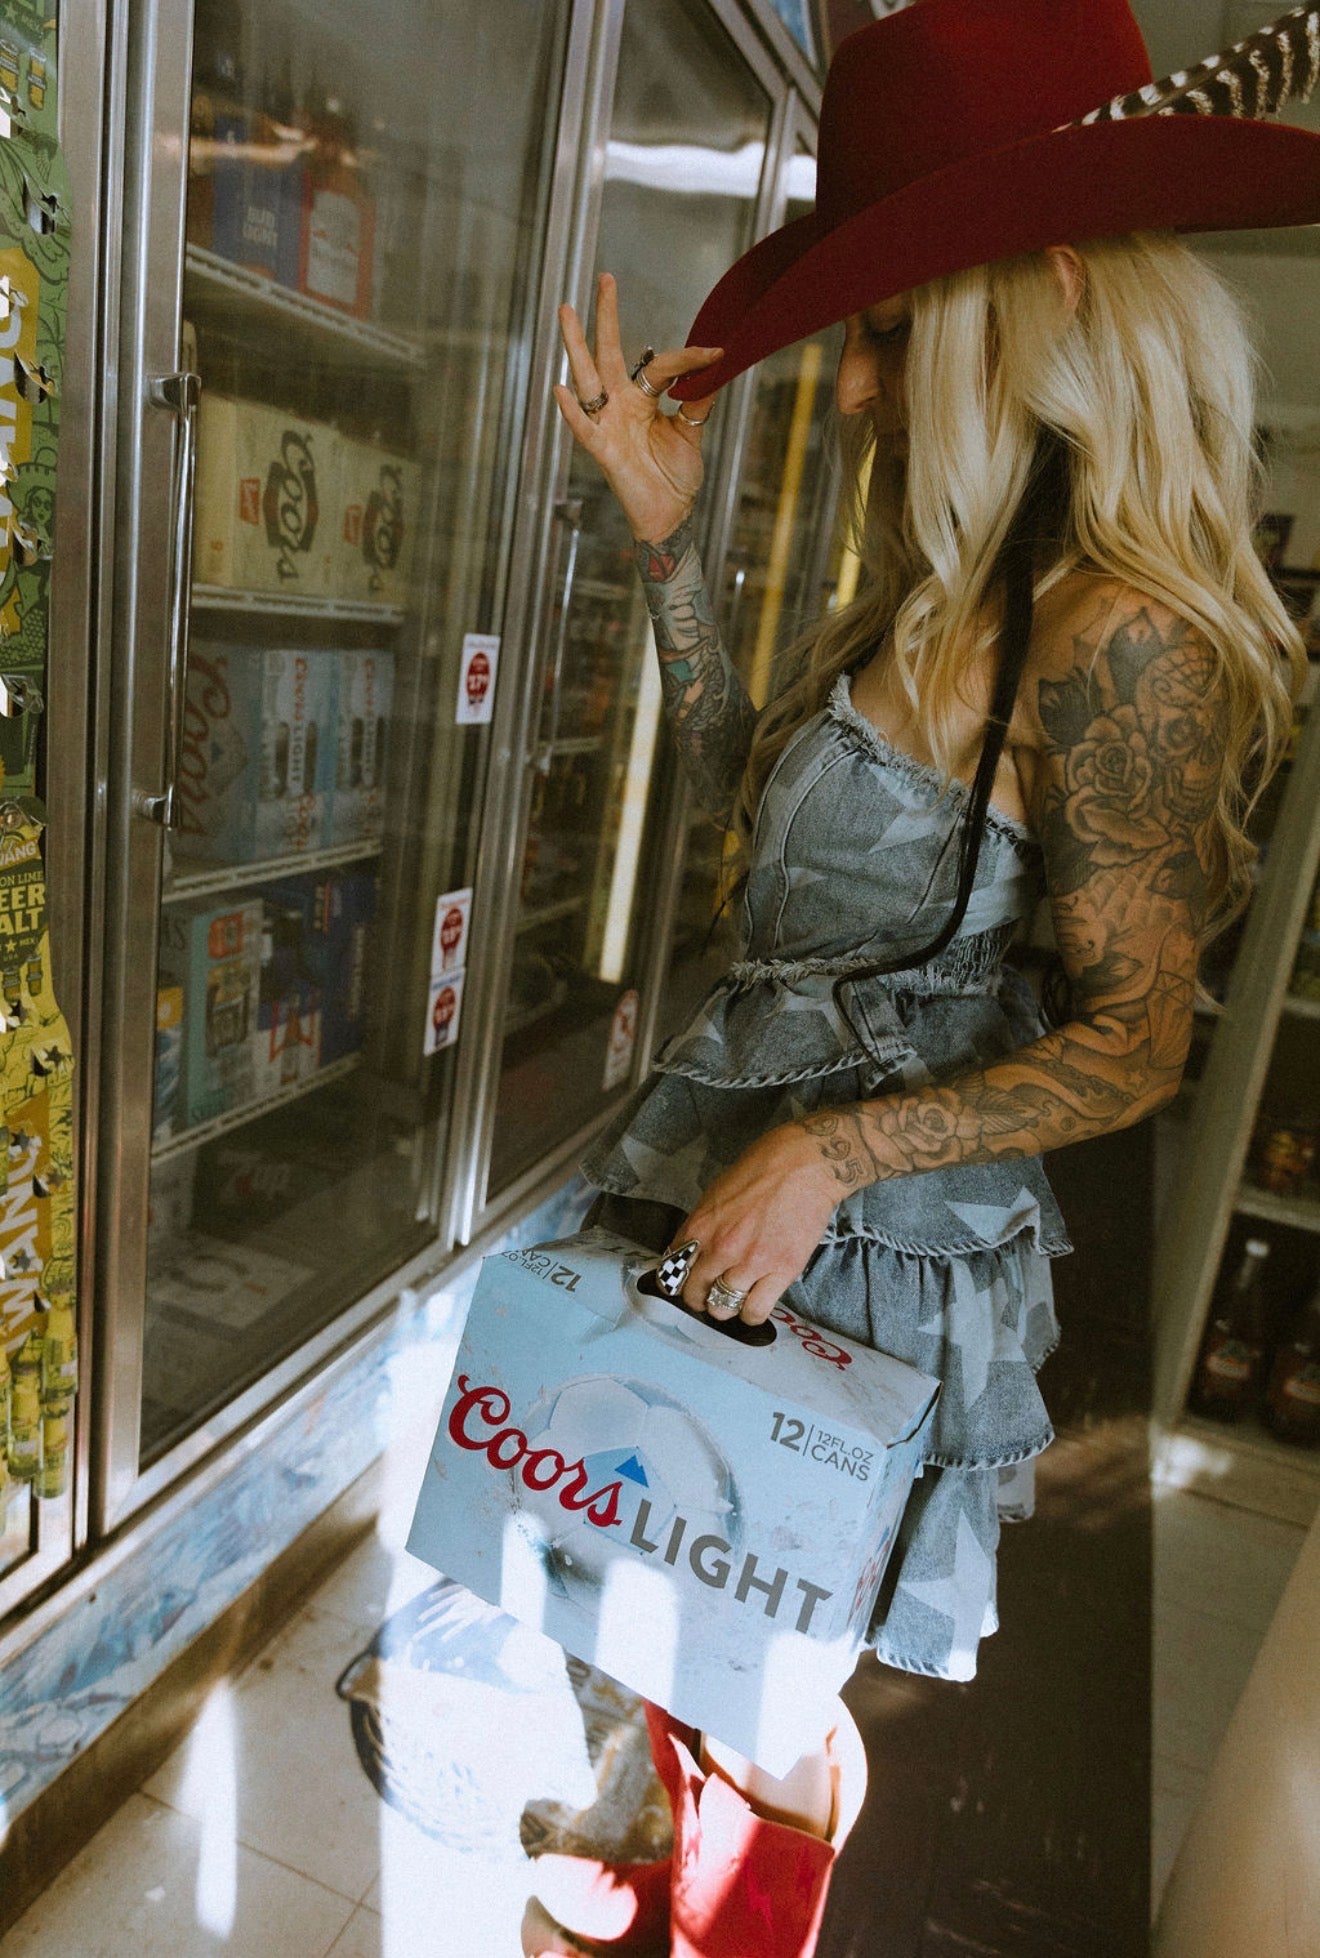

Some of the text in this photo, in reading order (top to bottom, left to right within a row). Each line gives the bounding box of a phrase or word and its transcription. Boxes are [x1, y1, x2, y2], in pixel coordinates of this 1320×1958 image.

[276, 430, 315, 582] Coors
[18, 871, 43, 884] LIME
[551, 1265, 582, 1293] 12
[448, 1375, 623, 1527] Coors
[770, 1411, 805, 1452] 12
[816, 1430, 874, 1464] 12FL.OZ
[811, 1444, 871, 1481] CANS
[630, 1499, 834, 1634] LIGHT
